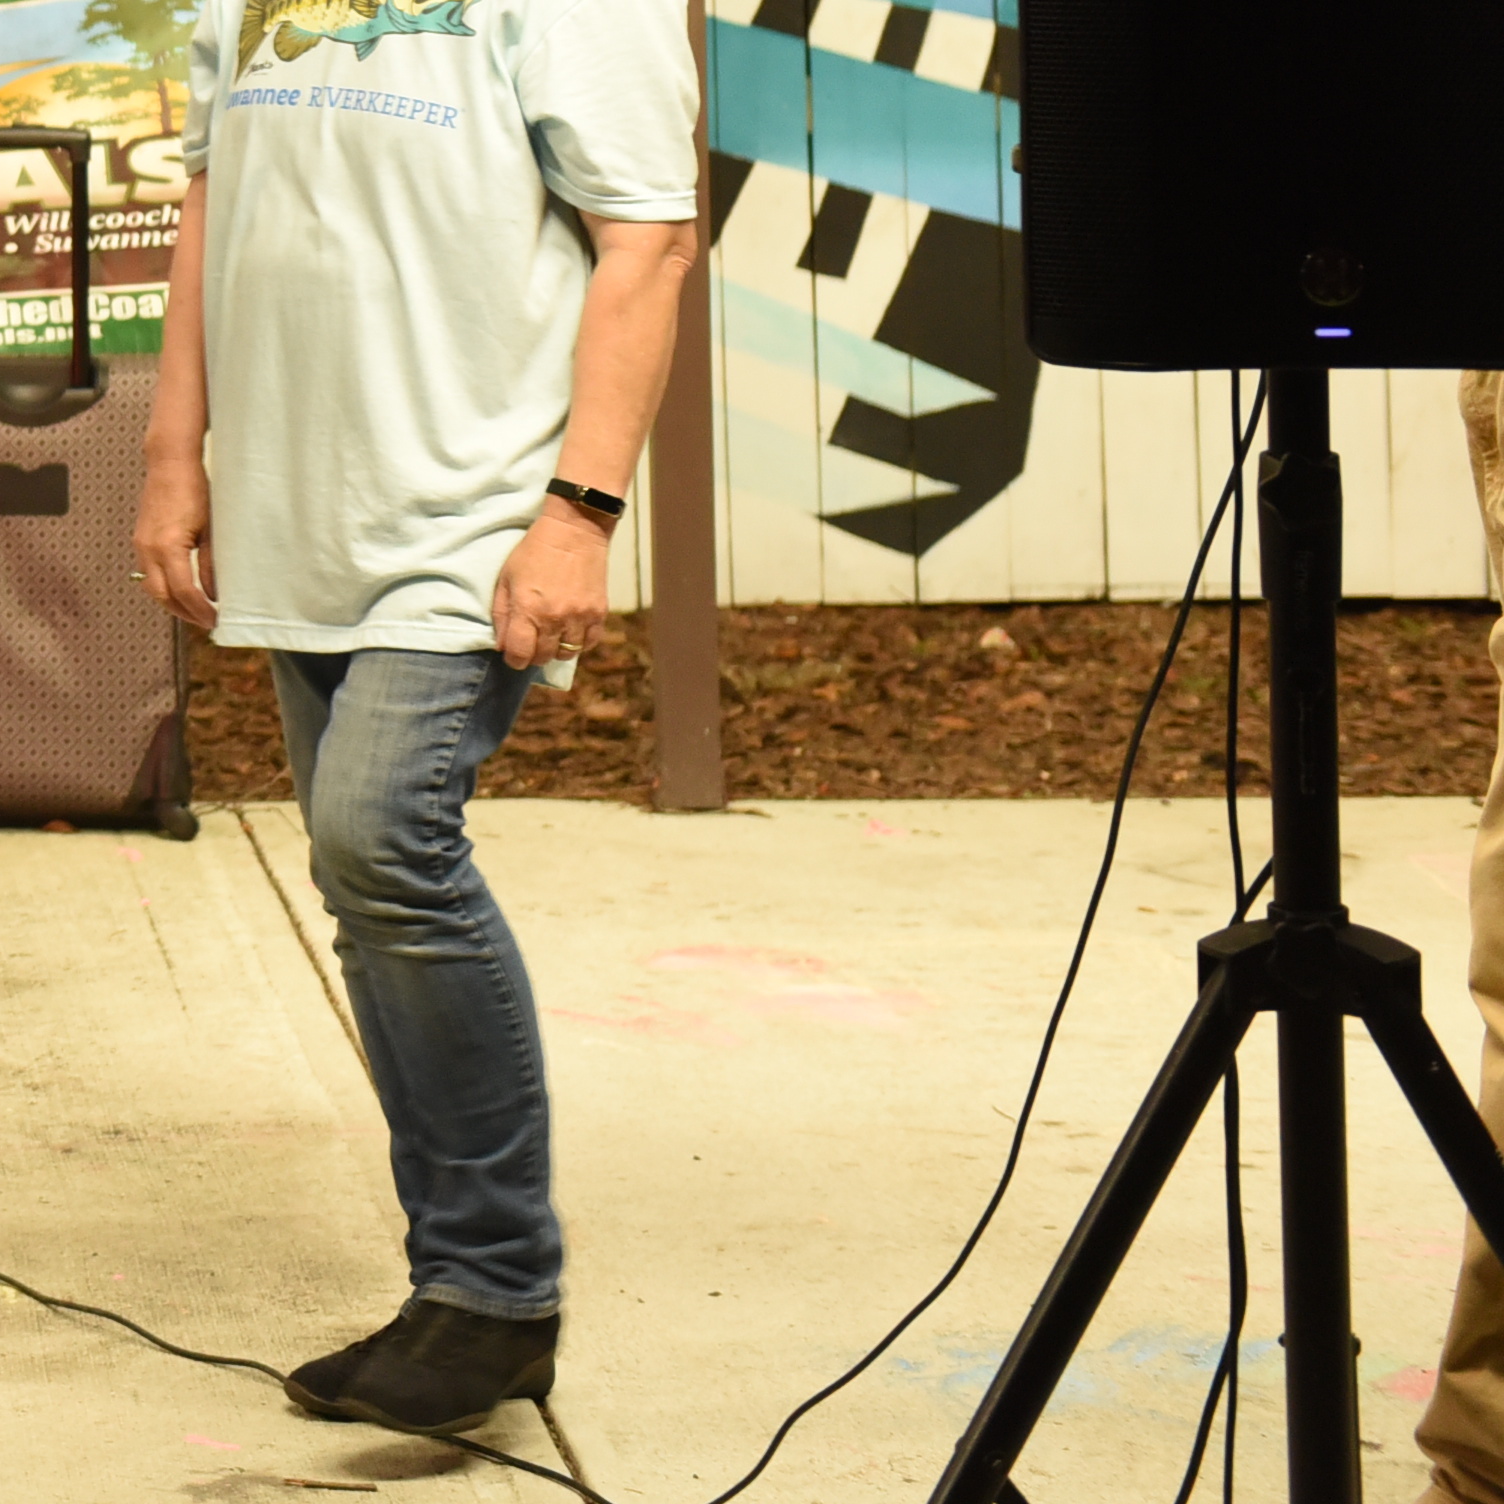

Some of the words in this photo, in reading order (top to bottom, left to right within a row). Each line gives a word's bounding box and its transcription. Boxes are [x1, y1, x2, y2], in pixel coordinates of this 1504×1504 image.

[226, 85, 301, 111] wannee
[4, 203, 182, 236] Willcooch
[33, 228, 180, 255] Suanne
